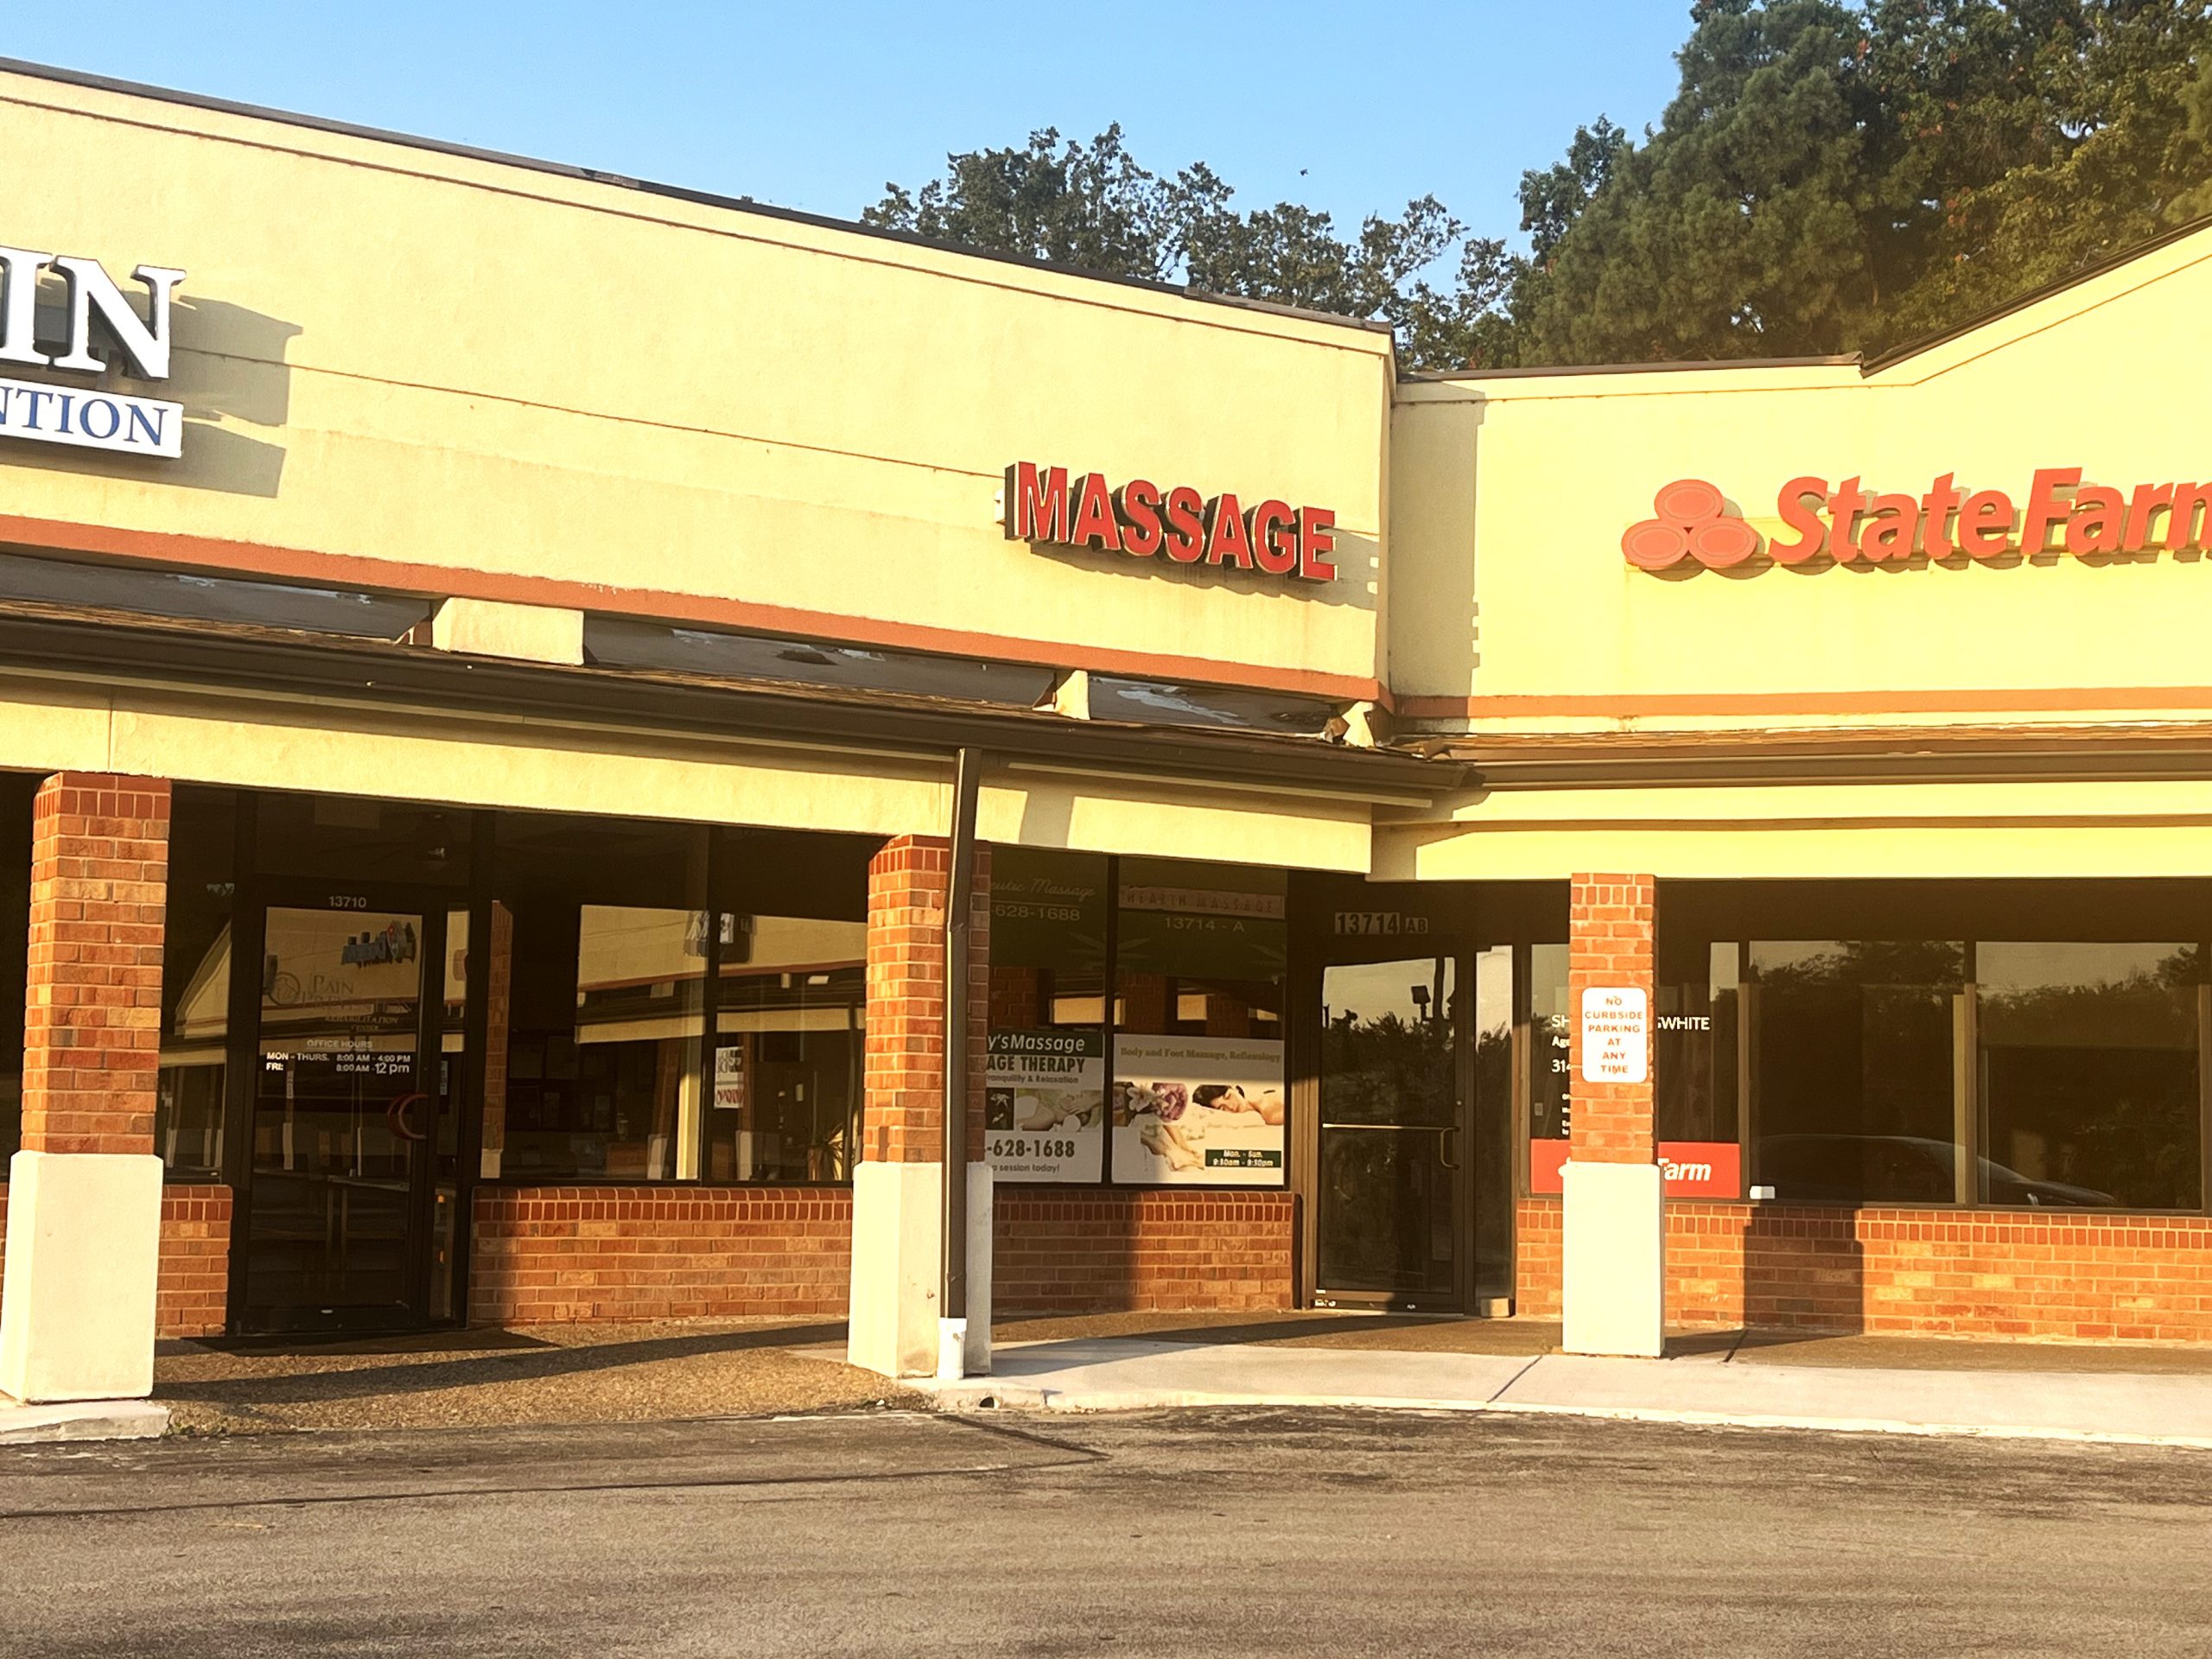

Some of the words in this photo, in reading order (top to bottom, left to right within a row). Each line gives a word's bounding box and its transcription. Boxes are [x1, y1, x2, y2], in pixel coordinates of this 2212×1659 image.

[1006, 461, 1338, 582] MASSAGE
[1031, 877, 1096, 902] Massage
[328, 895, 366, 908] 13710
[1196, 897, 1274, 912] MASSAGE
[1165, 917, 1216, 931] 13714
[1233, 920, 1245, 932] A
[1338, 913, 1398, 933] 13714
[1407, 918, 1427, 932] AB
[1605, 997, 1623, 1006] NO
[1585, 1011, 1643, 1020] CURBSIDE
[307, 1039, 339, 1048] OFFICE
[341, 1039, 373, 1048] HOURS
[266, 1052, 289, 1060] MON
[1121, 1047, 1142, 1058] Body
[1145, 1048, 1162, 1057] and
[389, 1064, 410, 1075] pm
[986, 1055, 1014, 1071] AGE
[1020, 1057, 1085, 1073] THERAPY
[1600, 1065, 1628, 1073] TIME
[1036, 1075, 1078, 1084] Relaxation
